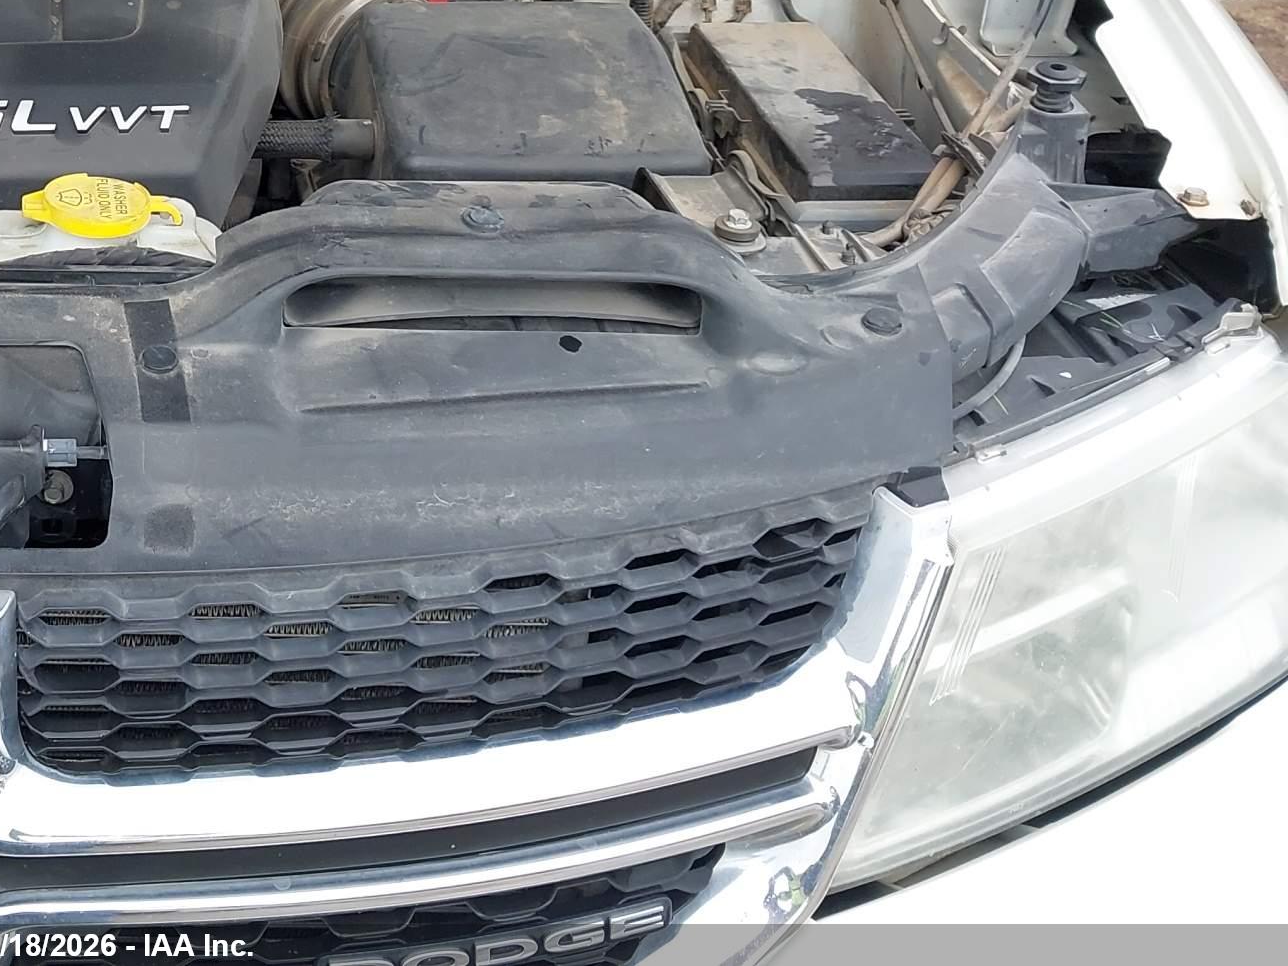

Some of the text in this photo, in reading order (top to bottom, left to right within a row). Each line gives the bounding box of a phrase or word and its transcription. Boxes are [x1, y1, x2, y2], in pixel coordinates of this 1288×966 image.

[69, 105, 191, 134] VVT
[96, 178, 112, 220] FLUID ONLY
[113, 184, 128, 215] WASHER
[328, 905, 666, 966] ODGE
